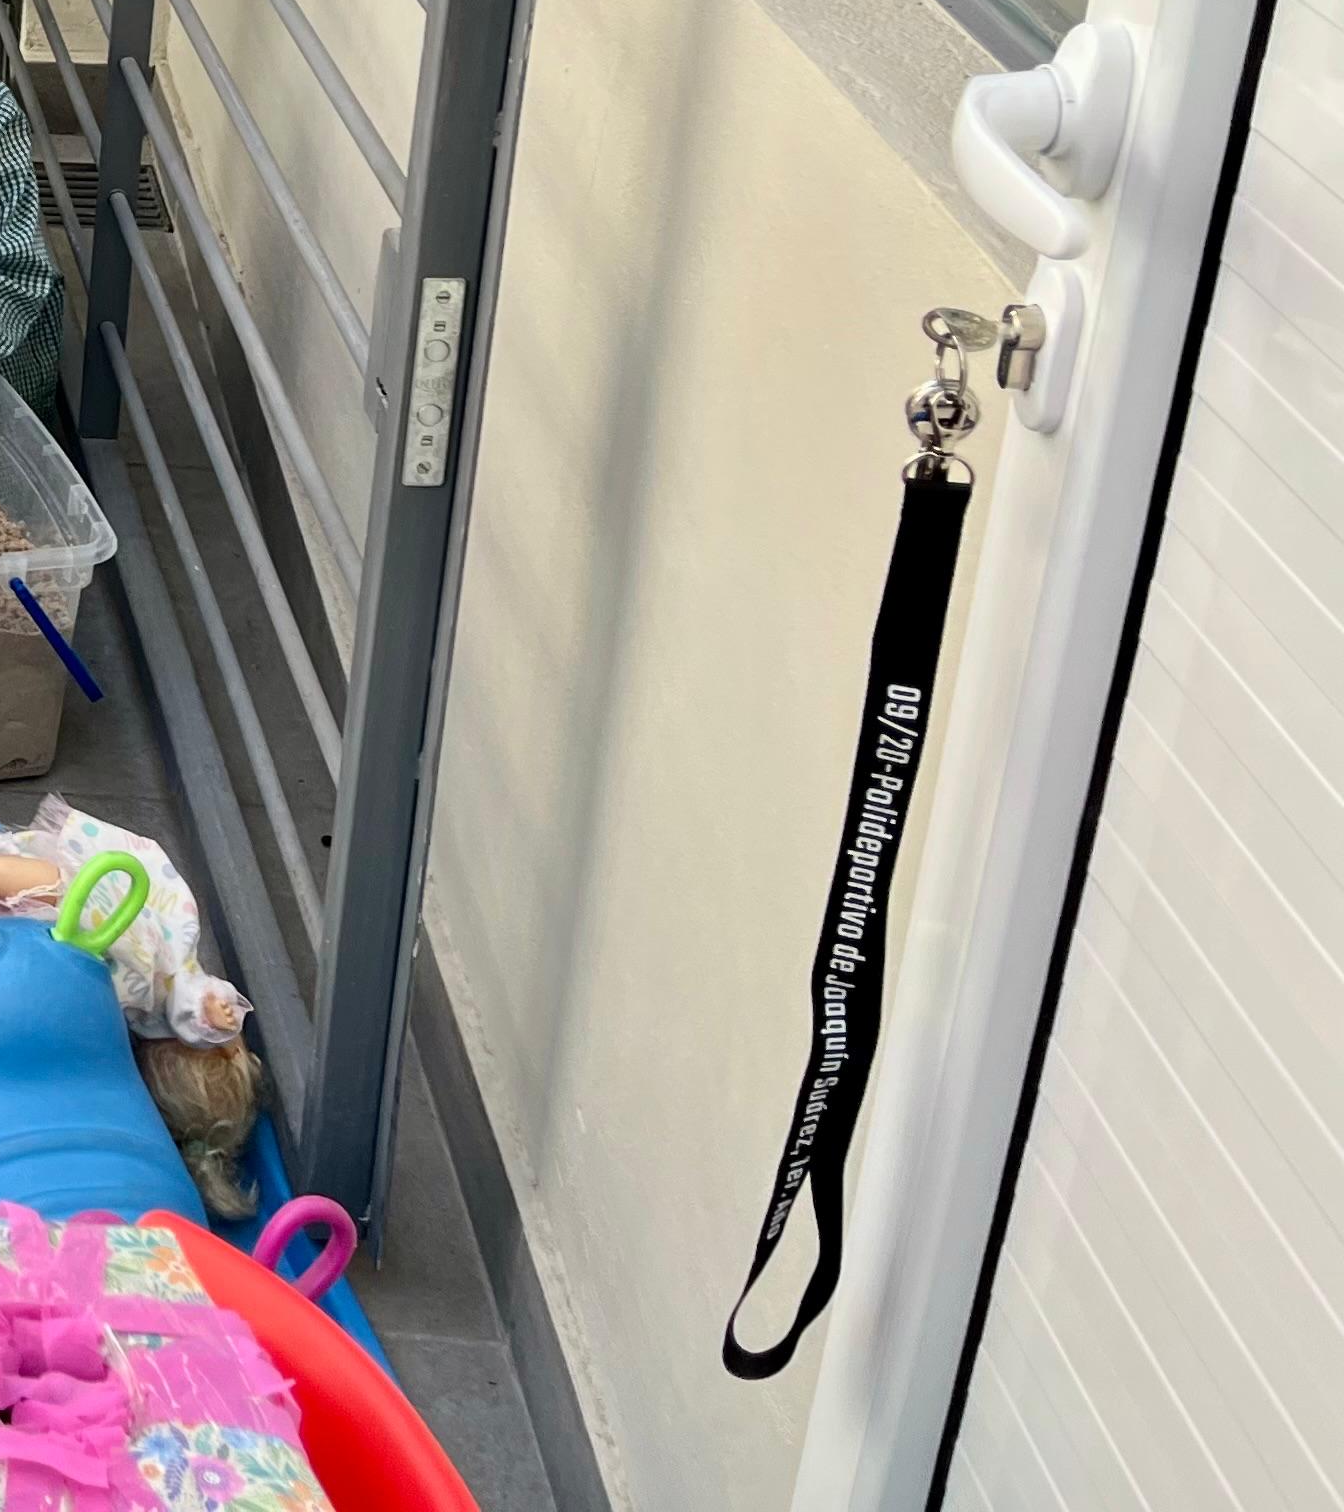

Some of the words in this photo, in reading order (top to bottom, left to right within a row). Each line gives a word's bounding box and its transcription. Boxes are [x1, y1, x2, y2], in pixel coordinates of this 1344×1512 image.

[837, 684, 921, 940] 09/20-Polideportivo
[829, 942, 866, 973] de
[819, 974, 856, 1073] Joaquín
